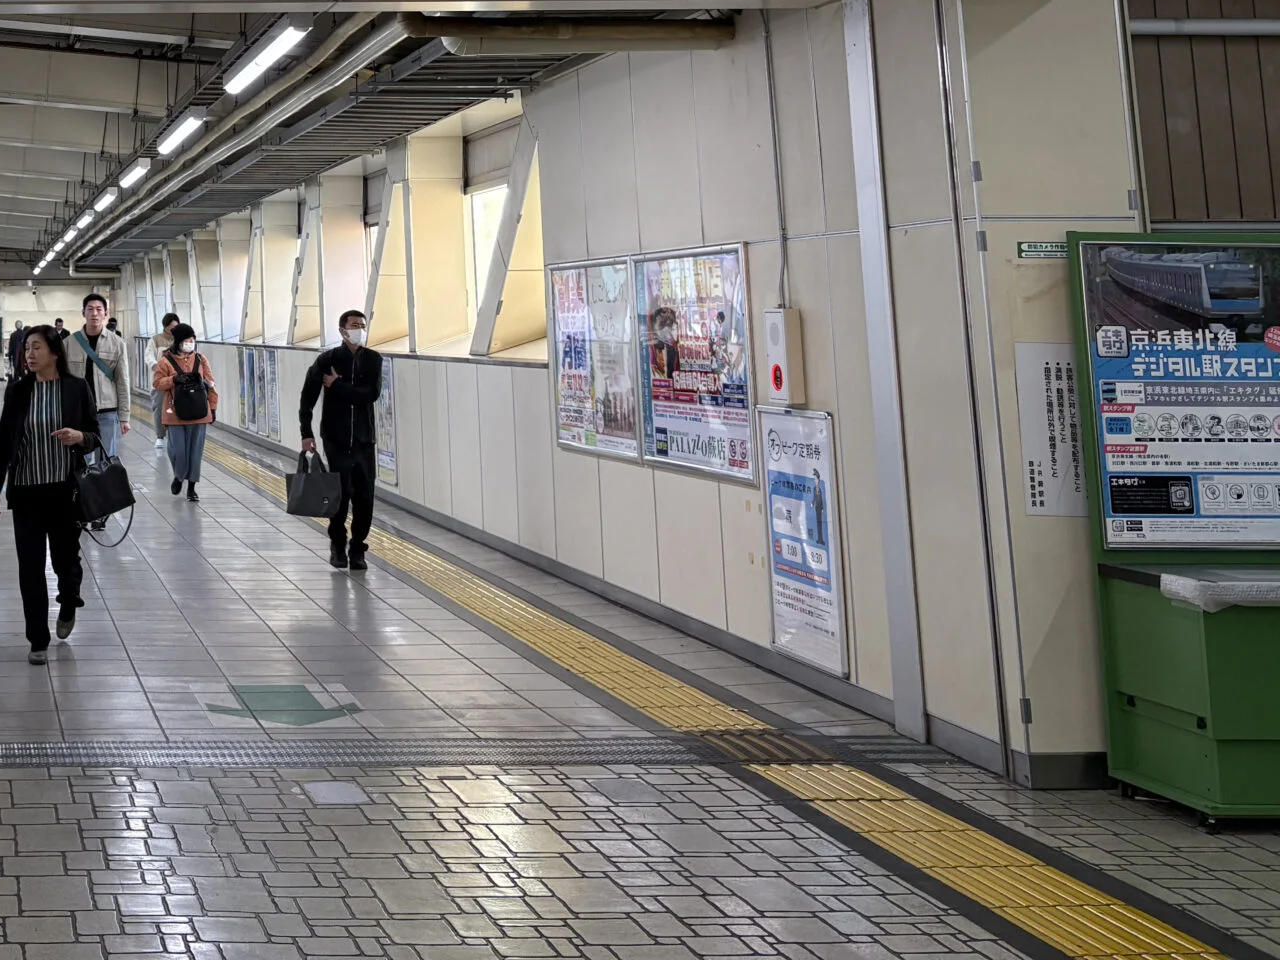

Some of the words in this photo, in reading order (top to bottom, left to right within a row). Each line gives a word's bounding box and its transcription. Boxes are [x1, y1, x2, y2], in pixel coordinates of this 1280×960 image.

[1129, 328, 1238, 352] 京浜東北線
